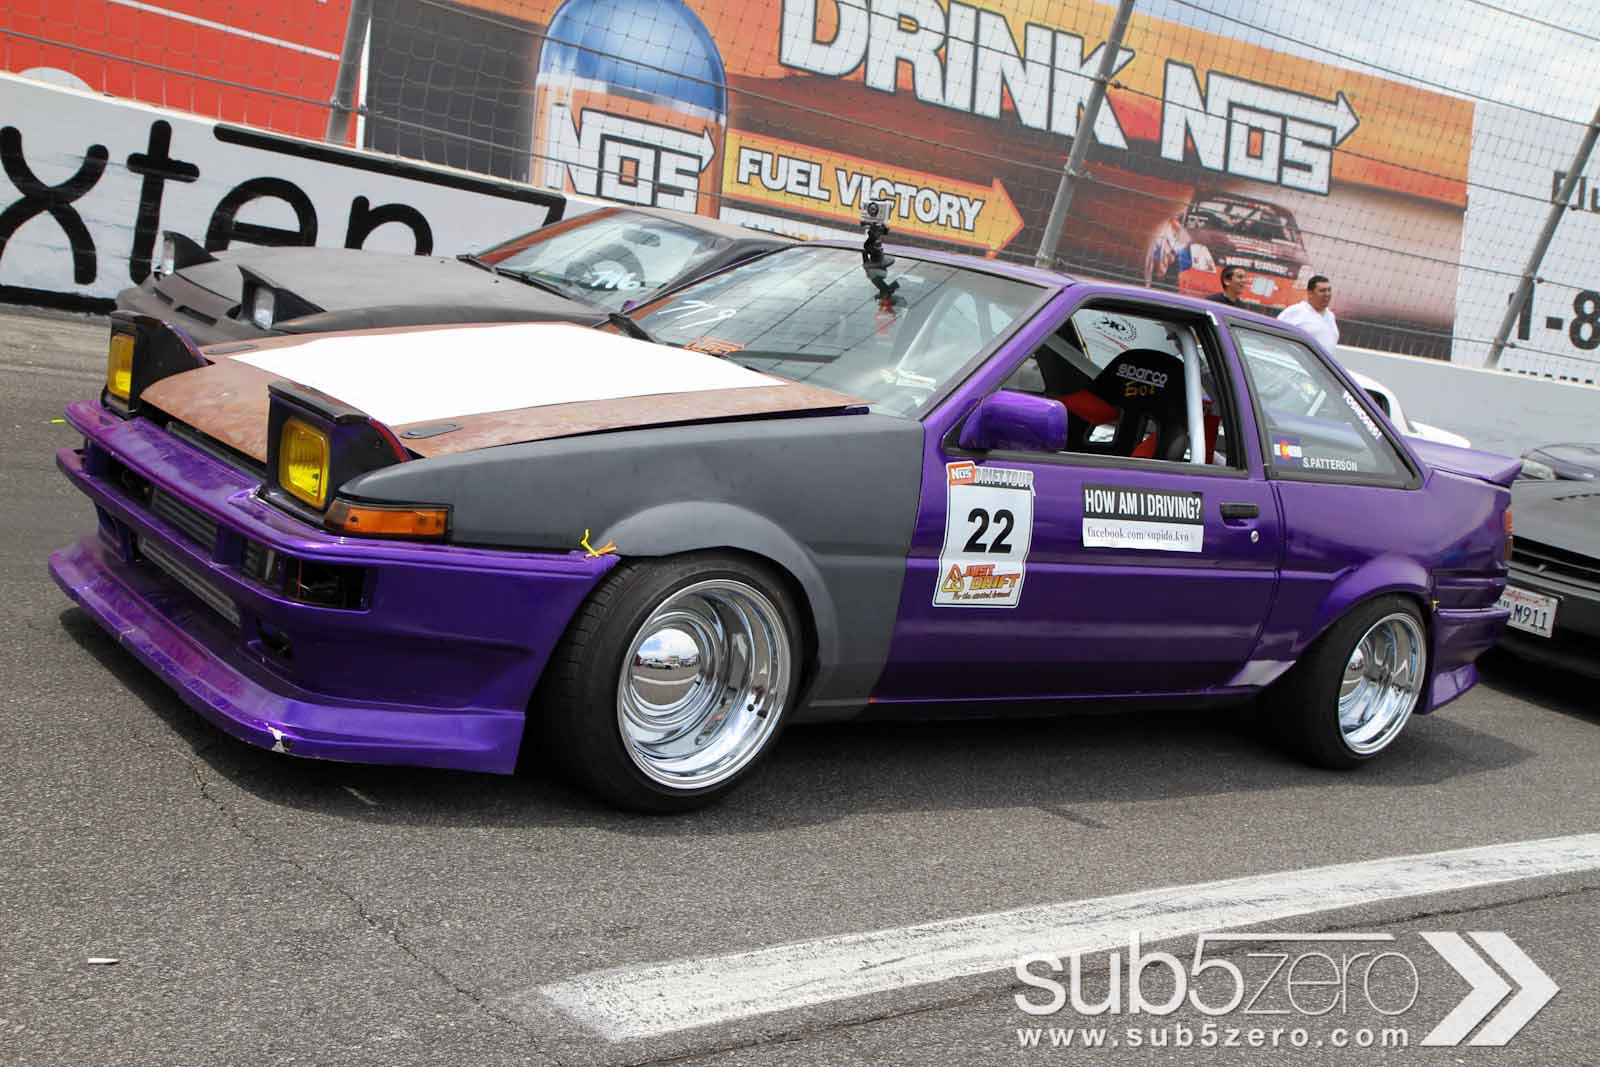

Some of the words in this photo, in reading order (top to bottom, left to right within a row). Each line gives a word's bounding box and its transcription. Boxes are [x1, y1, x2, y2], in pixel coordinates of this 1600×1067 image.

[780, 0, 1136, 150] DRINK
[1160, 58, 1360, 196] NOS
[543, 102, 716, 214] NOS
[737, 146, 831, 201] FUEL
[834, 168, 984, 232] VICTORY
[963, 508, 1014, 554] 22
[1084, 489, 1116, 514] HOW
[1118, 491, 1138, 515] AM
[1139, 493, 1145, 516] I
[1146, 494, 1201, 519] DRIVING?
